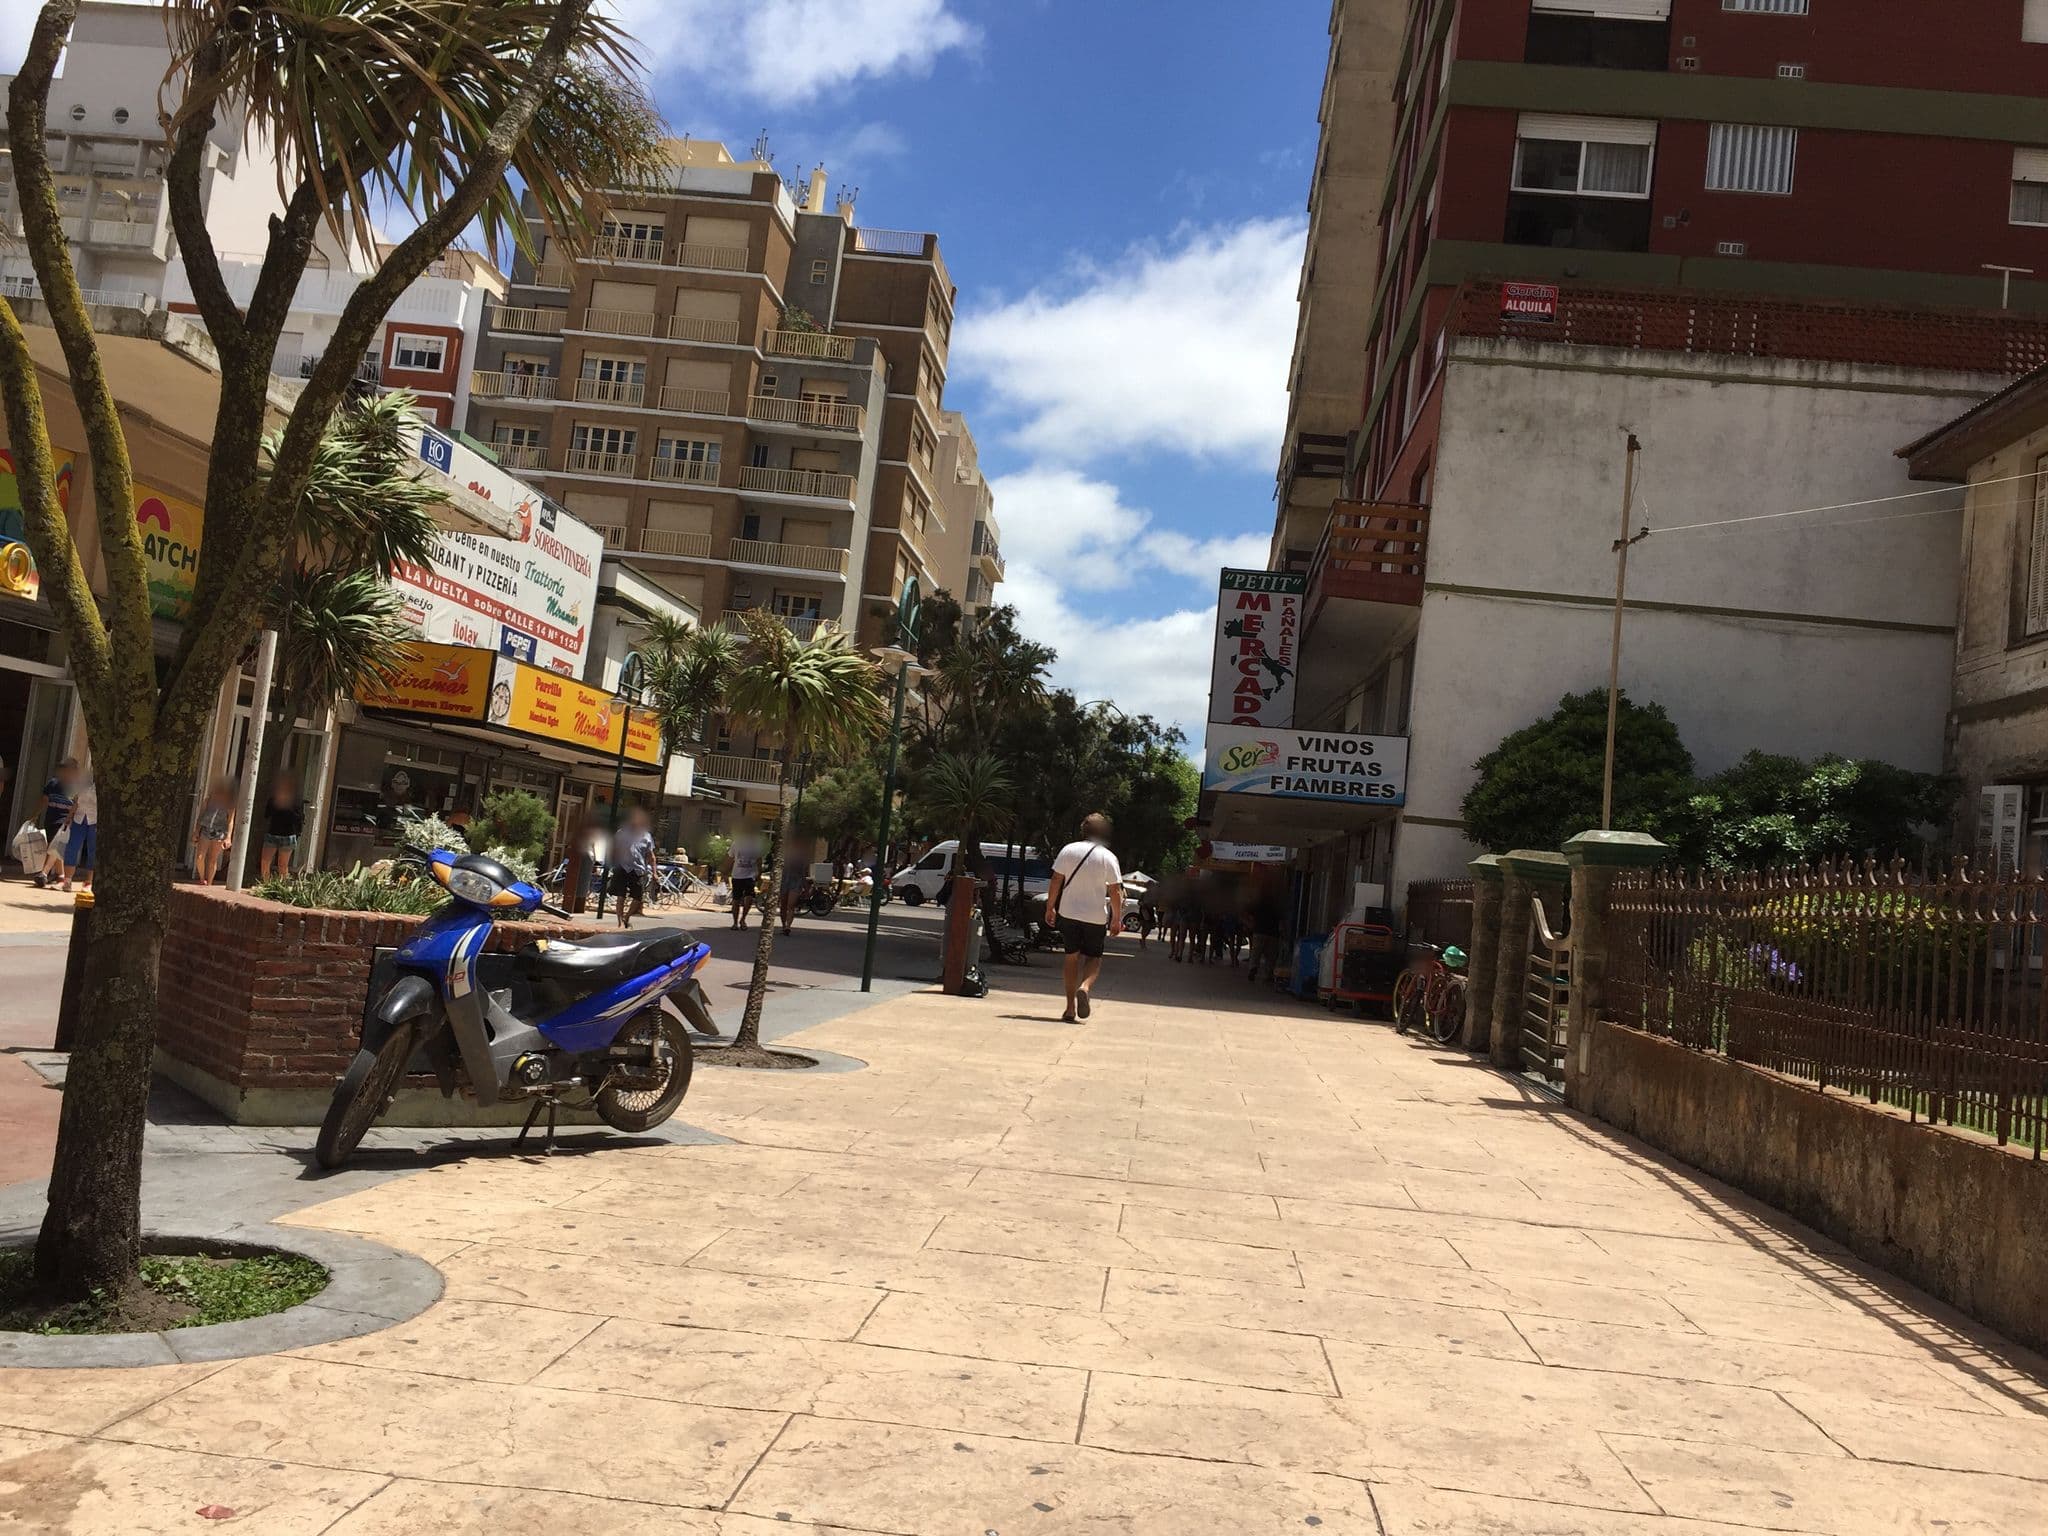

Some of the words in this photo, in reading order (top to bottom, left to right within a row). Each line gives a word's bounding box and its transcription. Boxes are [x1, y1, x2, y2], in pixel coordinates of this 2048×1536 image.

[1505, 299, 1551, 313] ALQUILA
[479, 540, 489, 557] en
[491, 548, 520, 573] nuestro
[533, 528, 592, 579] SORRENTINERÍA
[467, 563, 474, 579] y
[476, 565, 518, 597] PIZZERÍA
[405, 566, 421, 581] LA
[425, 573, 469, 604] VUELTA
[474, 598, 502, 617] sobre
[504, 609, 534, 631] CALLE
[536, 623, 547, 638] 14
[560, 635, 578, 651] 1120
[505, 631, 532, 653] PEPSI
[574, 710, 610, 742] Miramar
[1297, 736, 1375, 756] VINOS
[1286, 756, 1383, 777] FRUTAS
[1270, 775, 1397, 799] FIAMBRES
